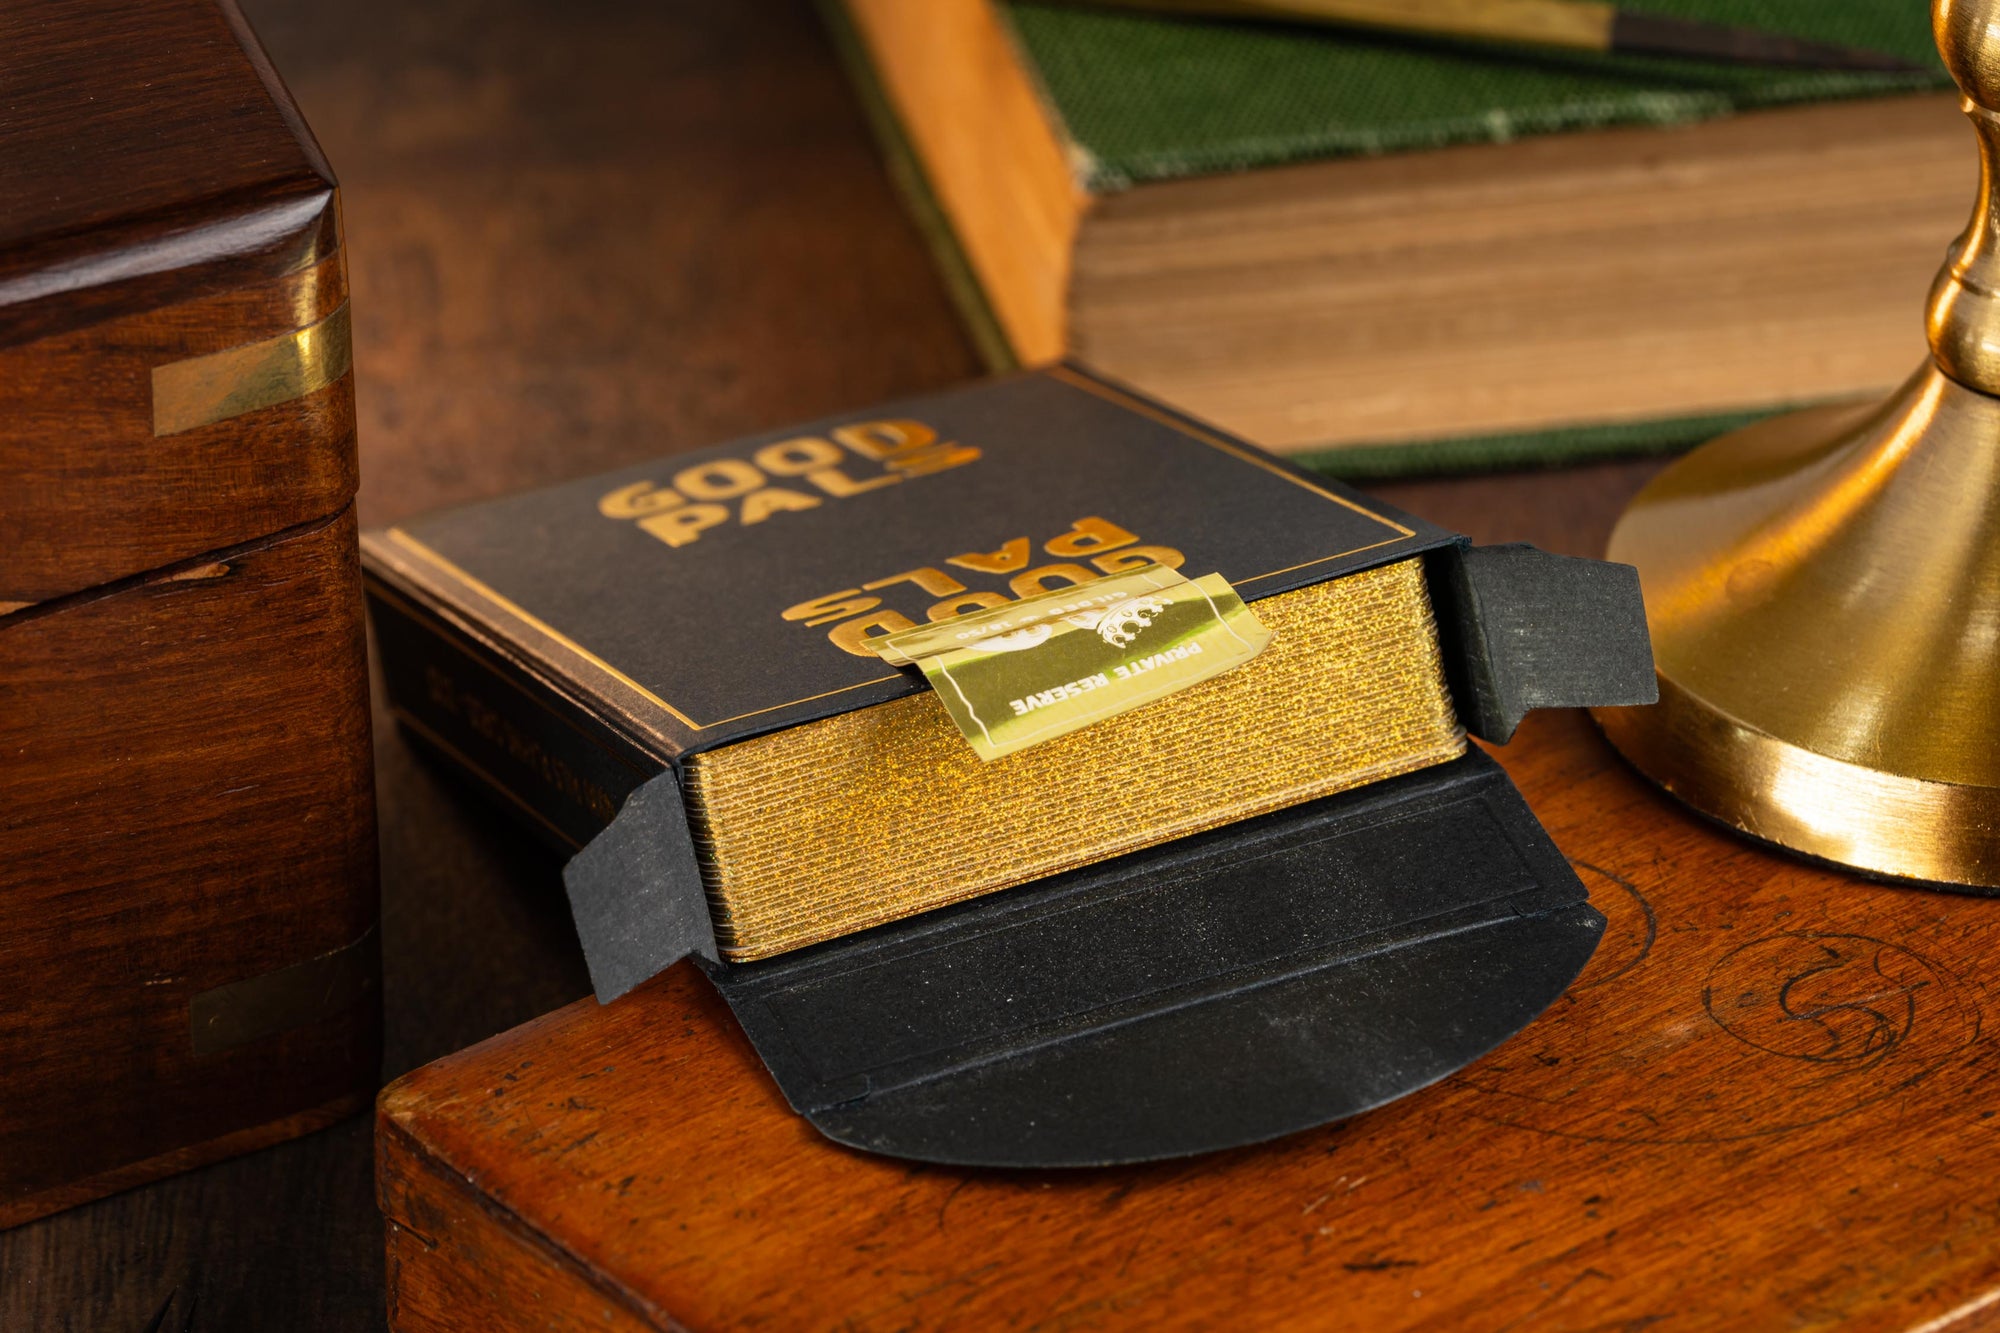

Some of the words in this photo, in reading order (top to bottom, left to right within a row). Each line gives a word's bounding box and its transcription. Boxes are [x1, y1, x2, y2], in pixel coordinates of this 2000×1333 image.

[598, 419, 937, 519] GOOD
[637, 442, 981, 547] PALS
[781, 515, 1140, 627] PALS
[1049, 591, 1127, 615] GILDED
[1008, 671, 1109, 716] RESERVE
[1113, 641, 1203, 681] PRIVATE
